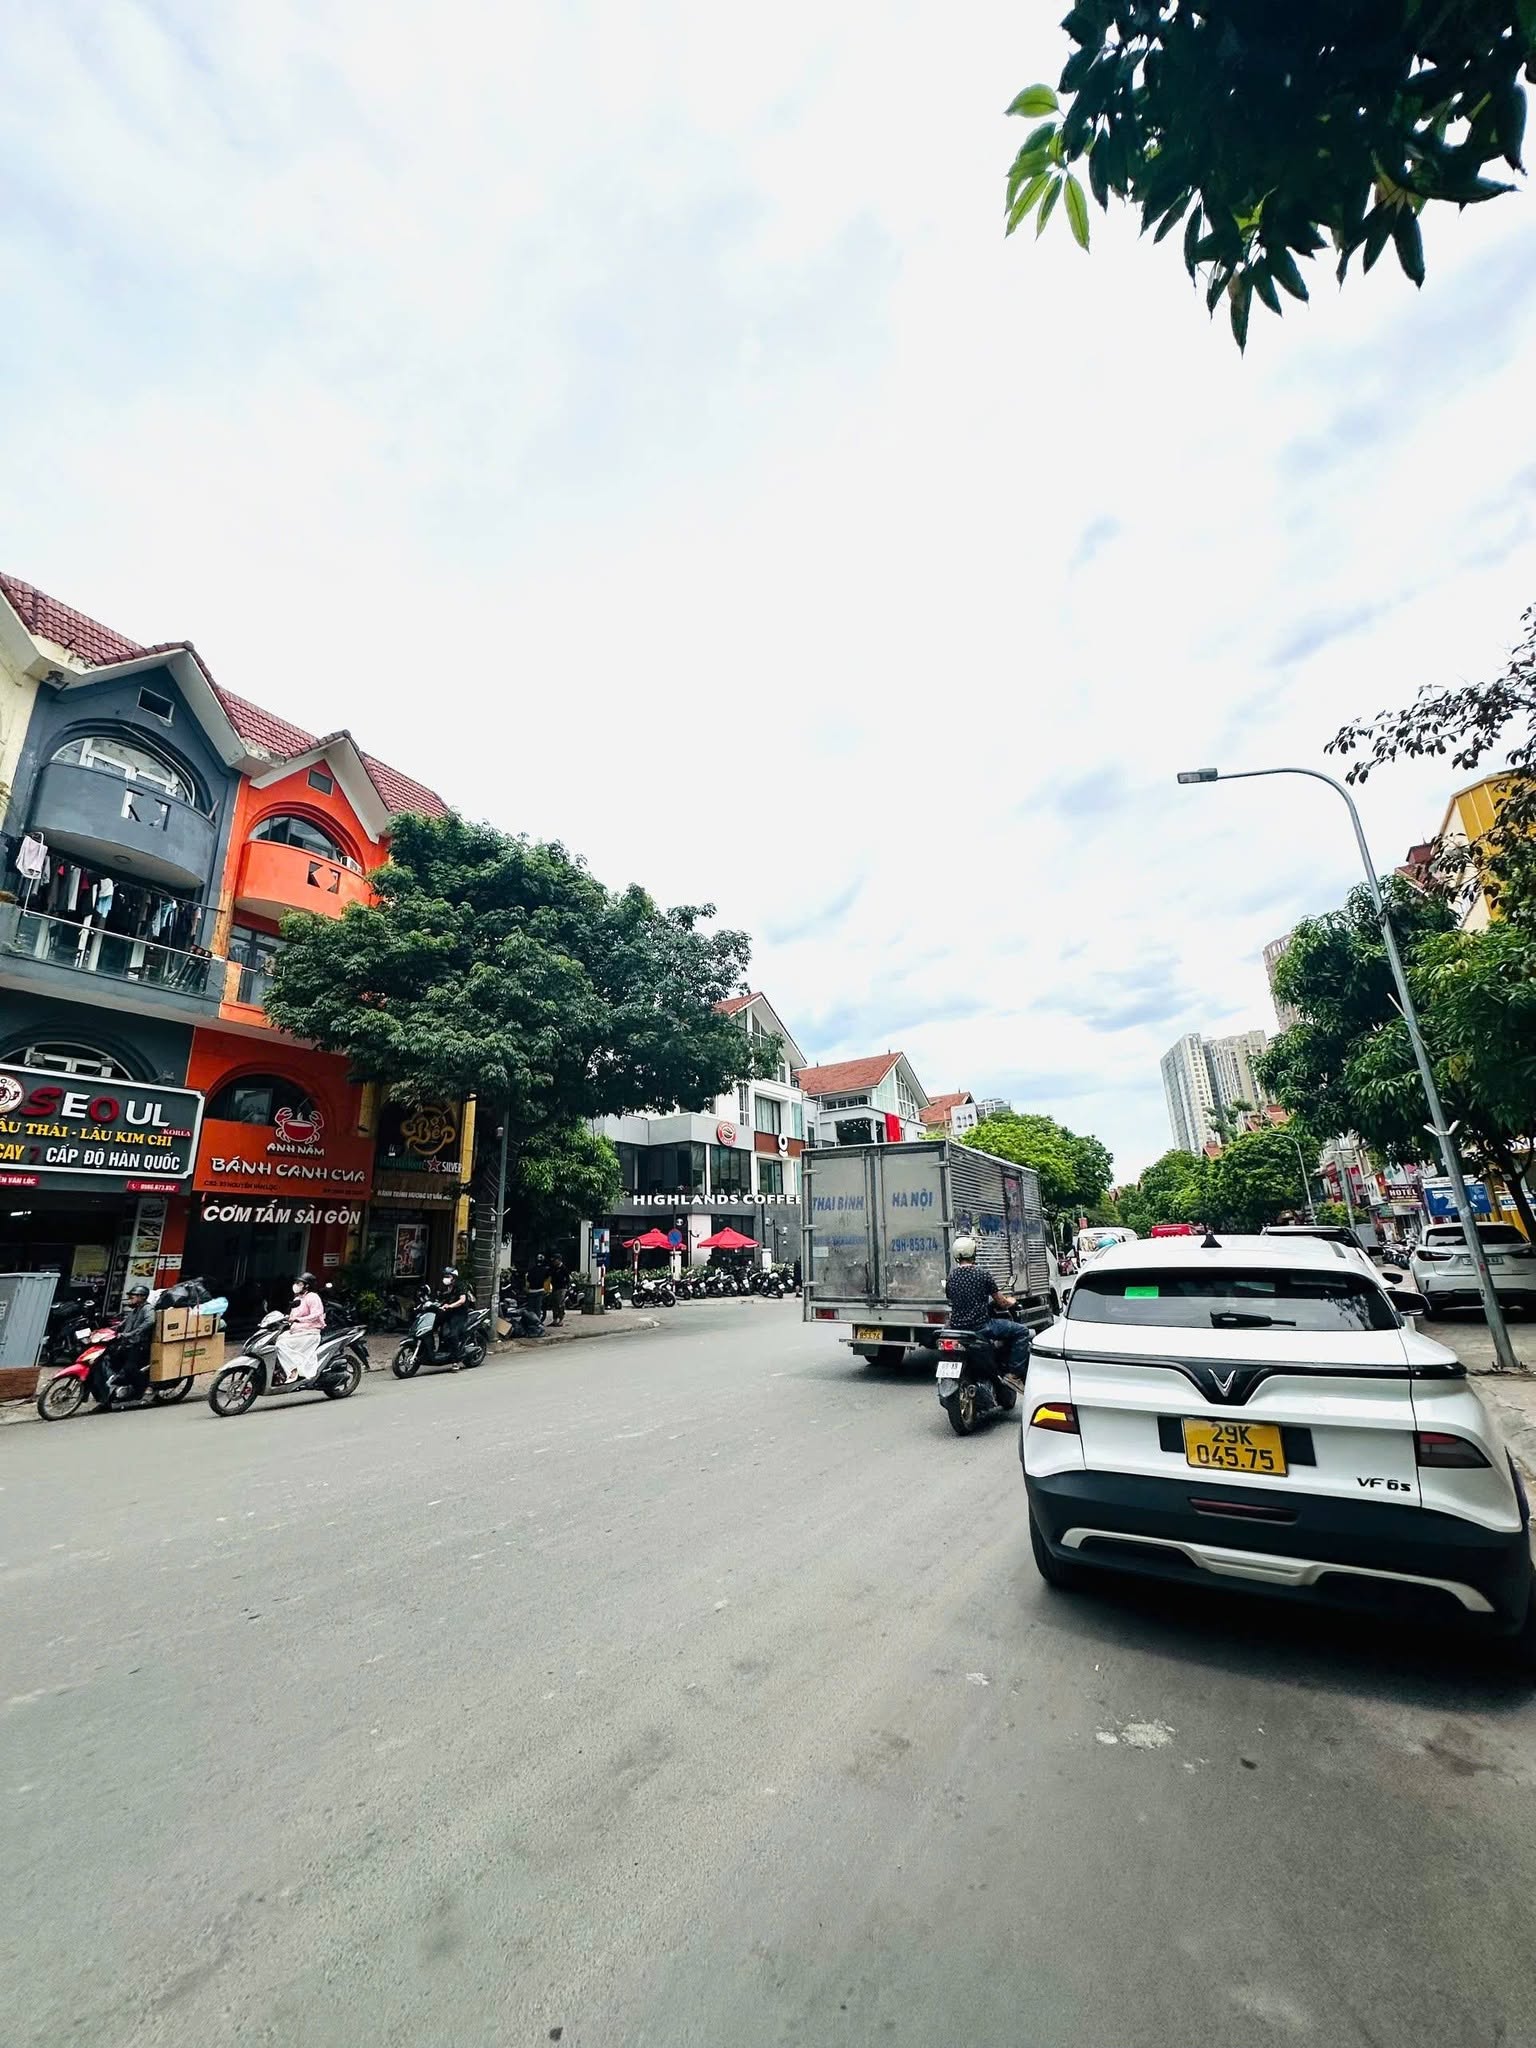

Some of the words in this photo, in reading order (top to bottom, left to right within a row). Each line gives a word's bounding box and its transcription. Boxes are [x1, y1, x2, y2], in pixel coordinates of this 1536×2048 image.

[20, 1086, 170, 1128] SEOUL
[25, 1121, 68, 1138] THÁI
[115, 1130, 145, 1145] KIM
[147, 1134, 173, 1147] CHI
[46, 1143, 79, 1164] CẤP
[83, 1147, 105, 1169] ĐỘ
[108, 1150, 140, 1168] HÀN
[143, 1151, 181, 1171] QUỐC
[266, 1142, 295, 1153] ANH
[211, 1156, 272, 1175] BÁNH
[275, 1163, 328, 1180] CANH
[331, 1168, 367, 1183] CUA
[633, 1194, 739, 1206] HIGHLANDS
[910, 1188, 933, 1211] NỘI
[1388, 1189, 1418, 1197] HOTEL
[203, 1205, 252, 1222] CƠM
[254, 1199, 292, 1223] TẤM
[294, 1203, 322, 1224] SÀI
[324, 1206, 361, 1225] GÒN
[1211, 1423, 1253, 1445] 29K
[1196, 1444, 1275, 1471] 045.75
[1356, 1476, 1385, 1489] VF
